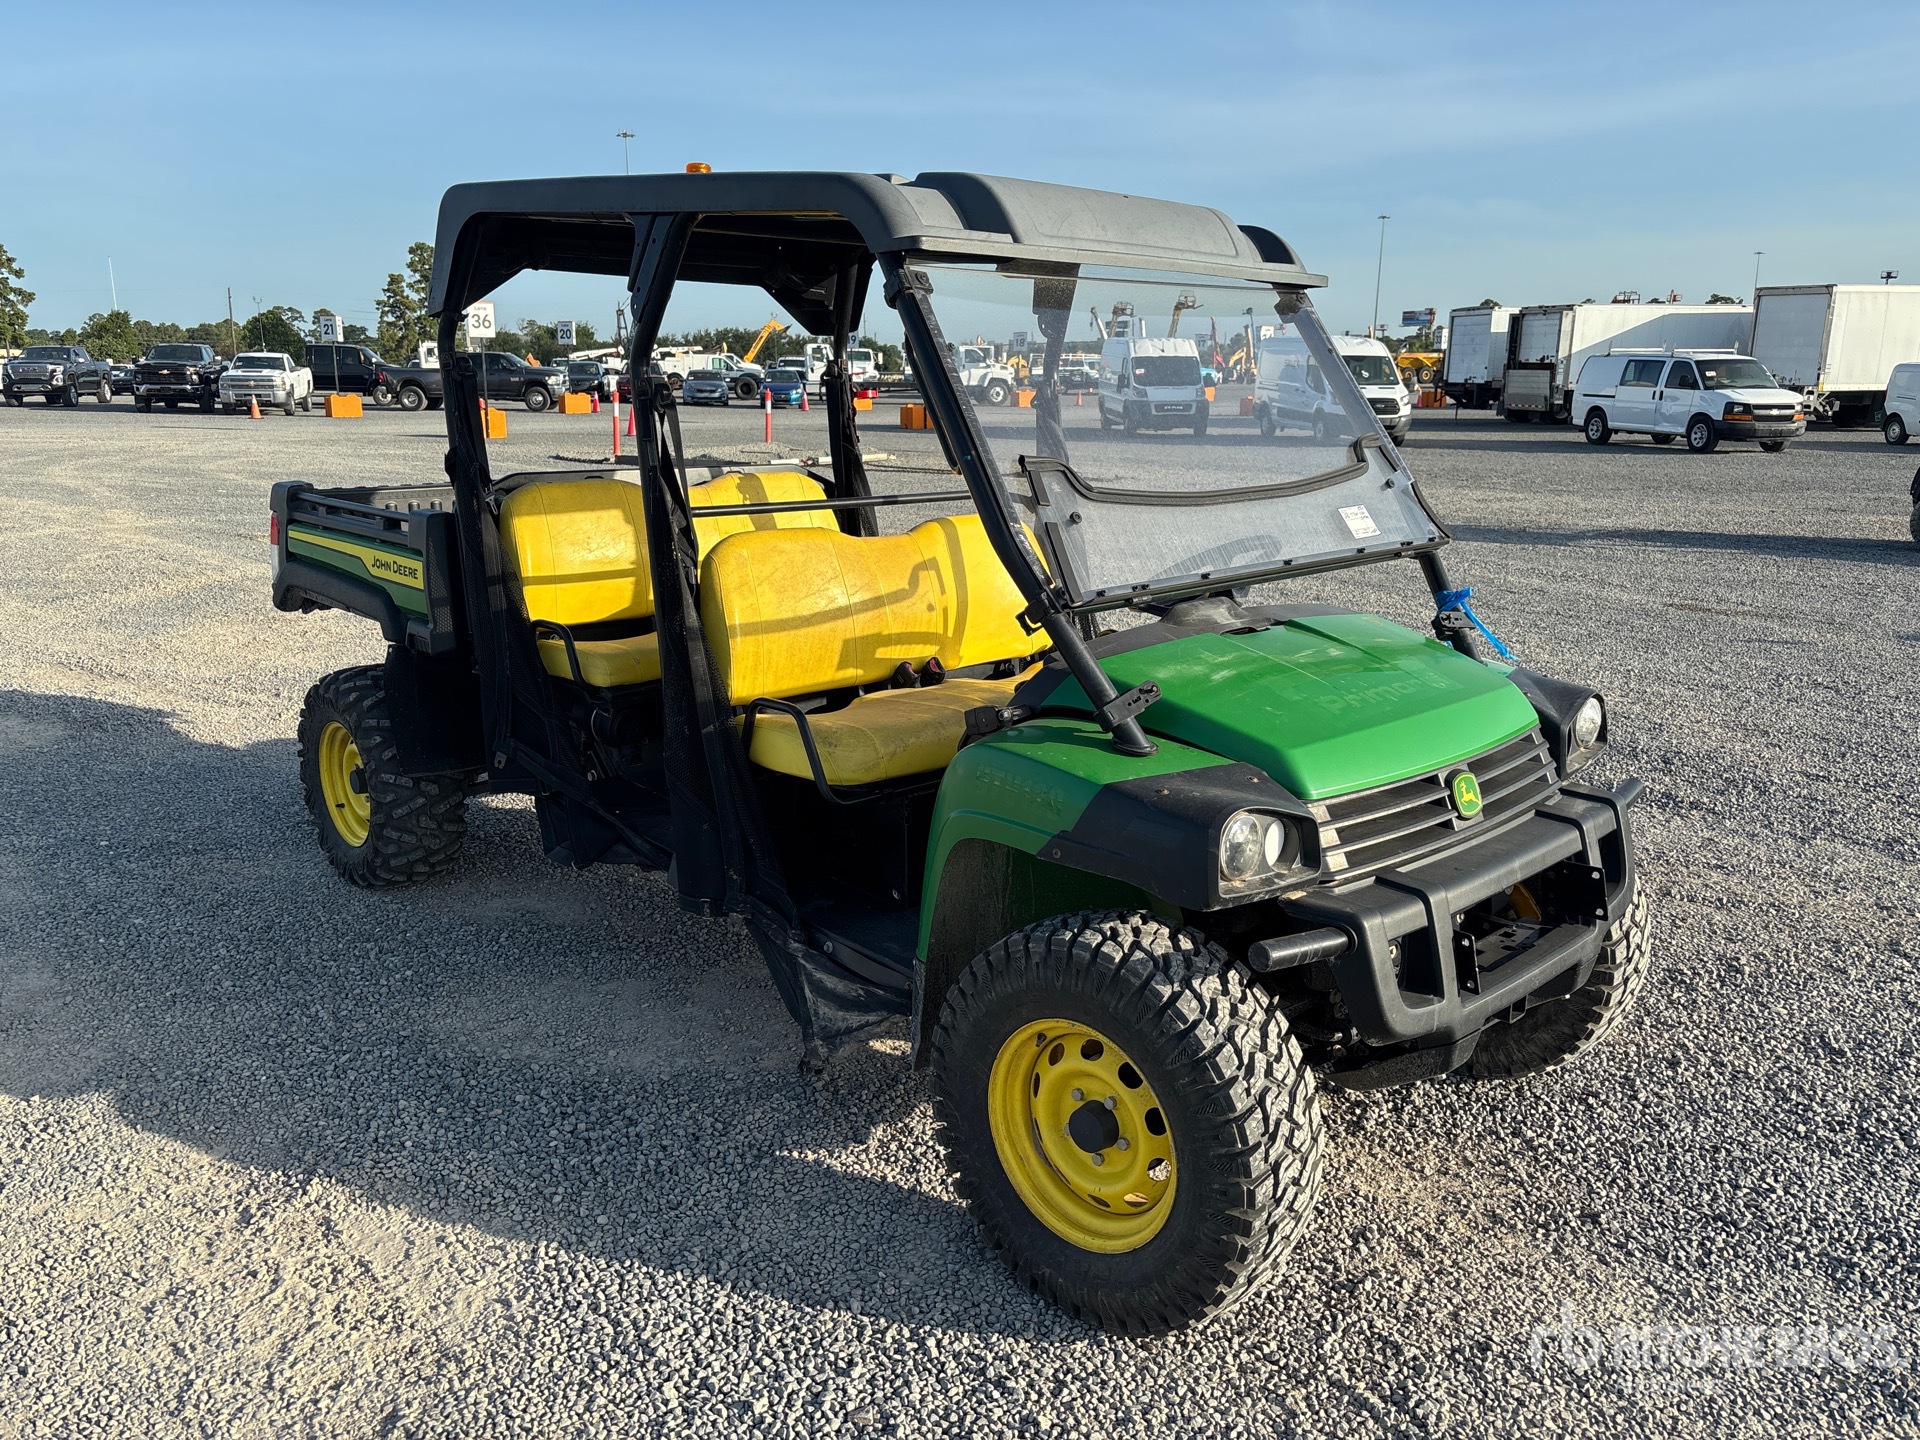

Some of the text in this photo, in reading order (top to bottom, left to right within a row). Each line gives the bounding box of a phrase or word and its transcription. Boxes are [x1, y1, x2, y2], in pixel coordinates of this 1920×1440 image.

[471, 313, 492, 329] 36
[323, 323, 334, 335] 21
[559, 329, 571, 339] 20
[1016, 338, 1024, 347] 18
[1197, 339, 1206, 348] 17
[372, 556, 418, 579] JOHN DEERE
